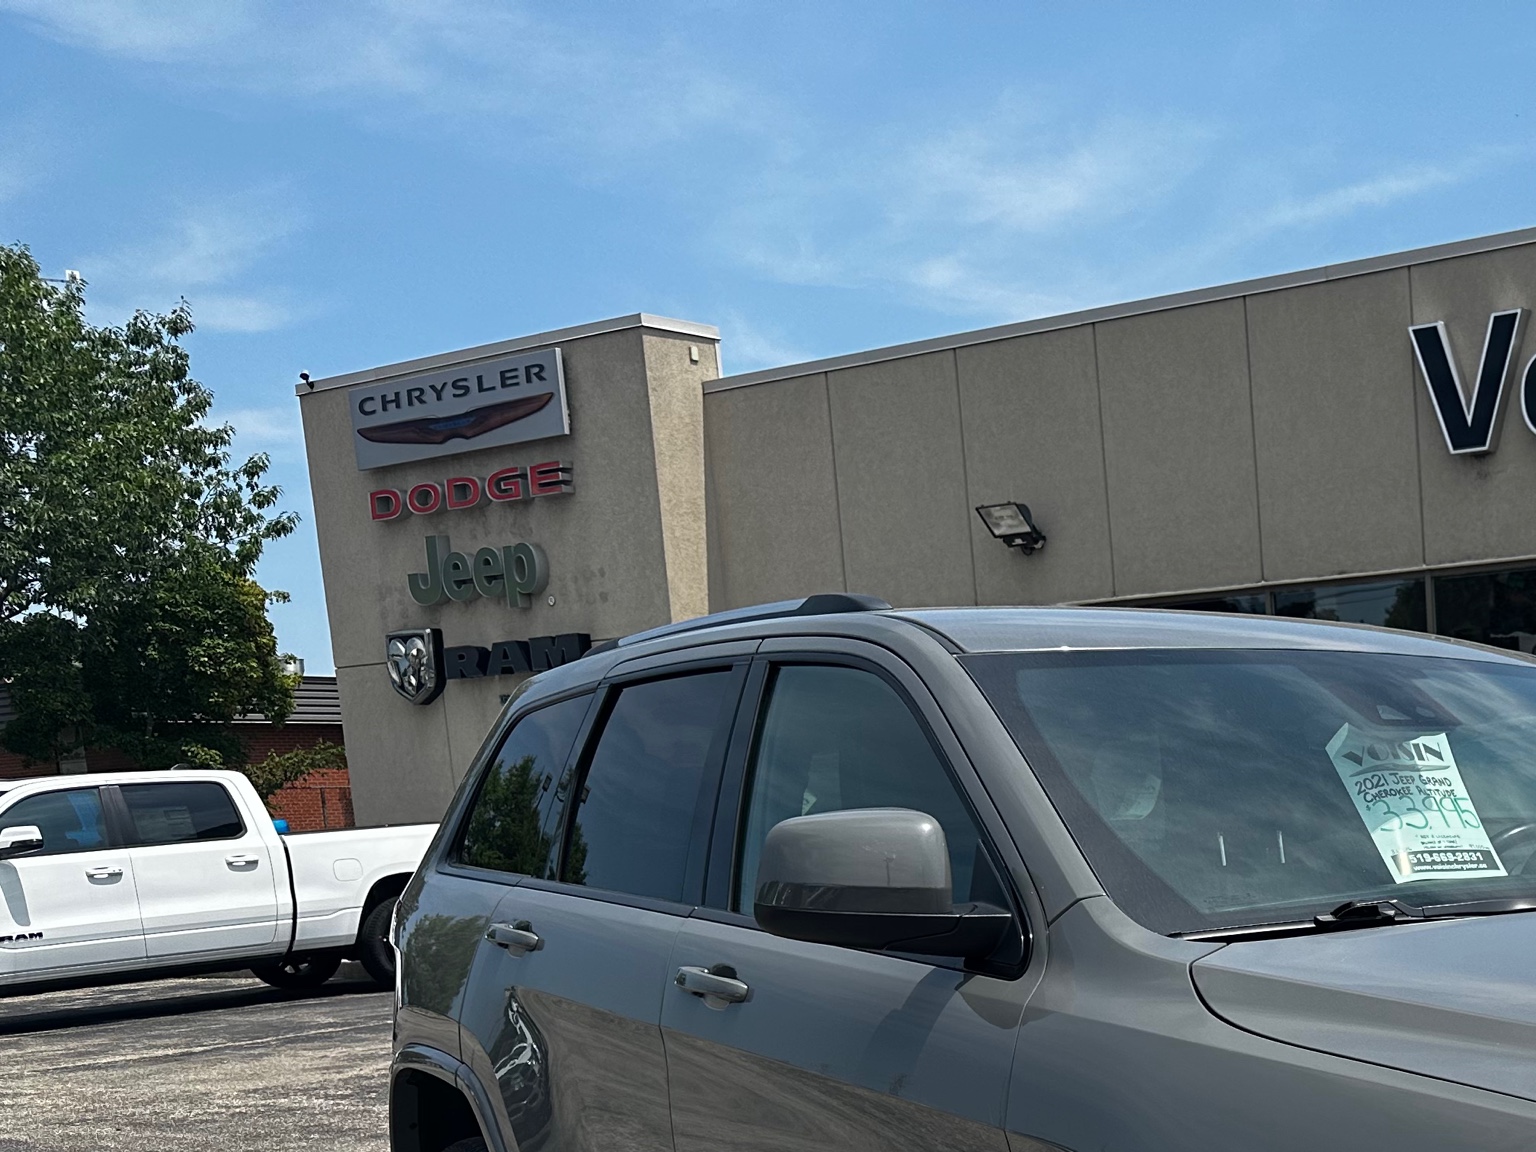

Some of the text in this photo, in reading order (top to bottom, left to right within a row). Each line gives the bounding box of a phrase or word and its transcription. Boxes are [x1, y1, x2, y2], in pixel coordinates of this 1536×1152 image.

[357, 362, 548, 417] CHRYSLER
[368, 460, 573, 522] DODGE
[406, 534, 547, 609] Jeep
[443, 632, 591, 680] RAM
[1341, 741, 1446, 768] VOISIN
[1354, 772, 1453, 796] 2021 JEEP GRAND
[1362, 785, 1457, 804] CHEROKEE ALTITUDE
[1410, 852, 1484, 864] 519-669-2831
